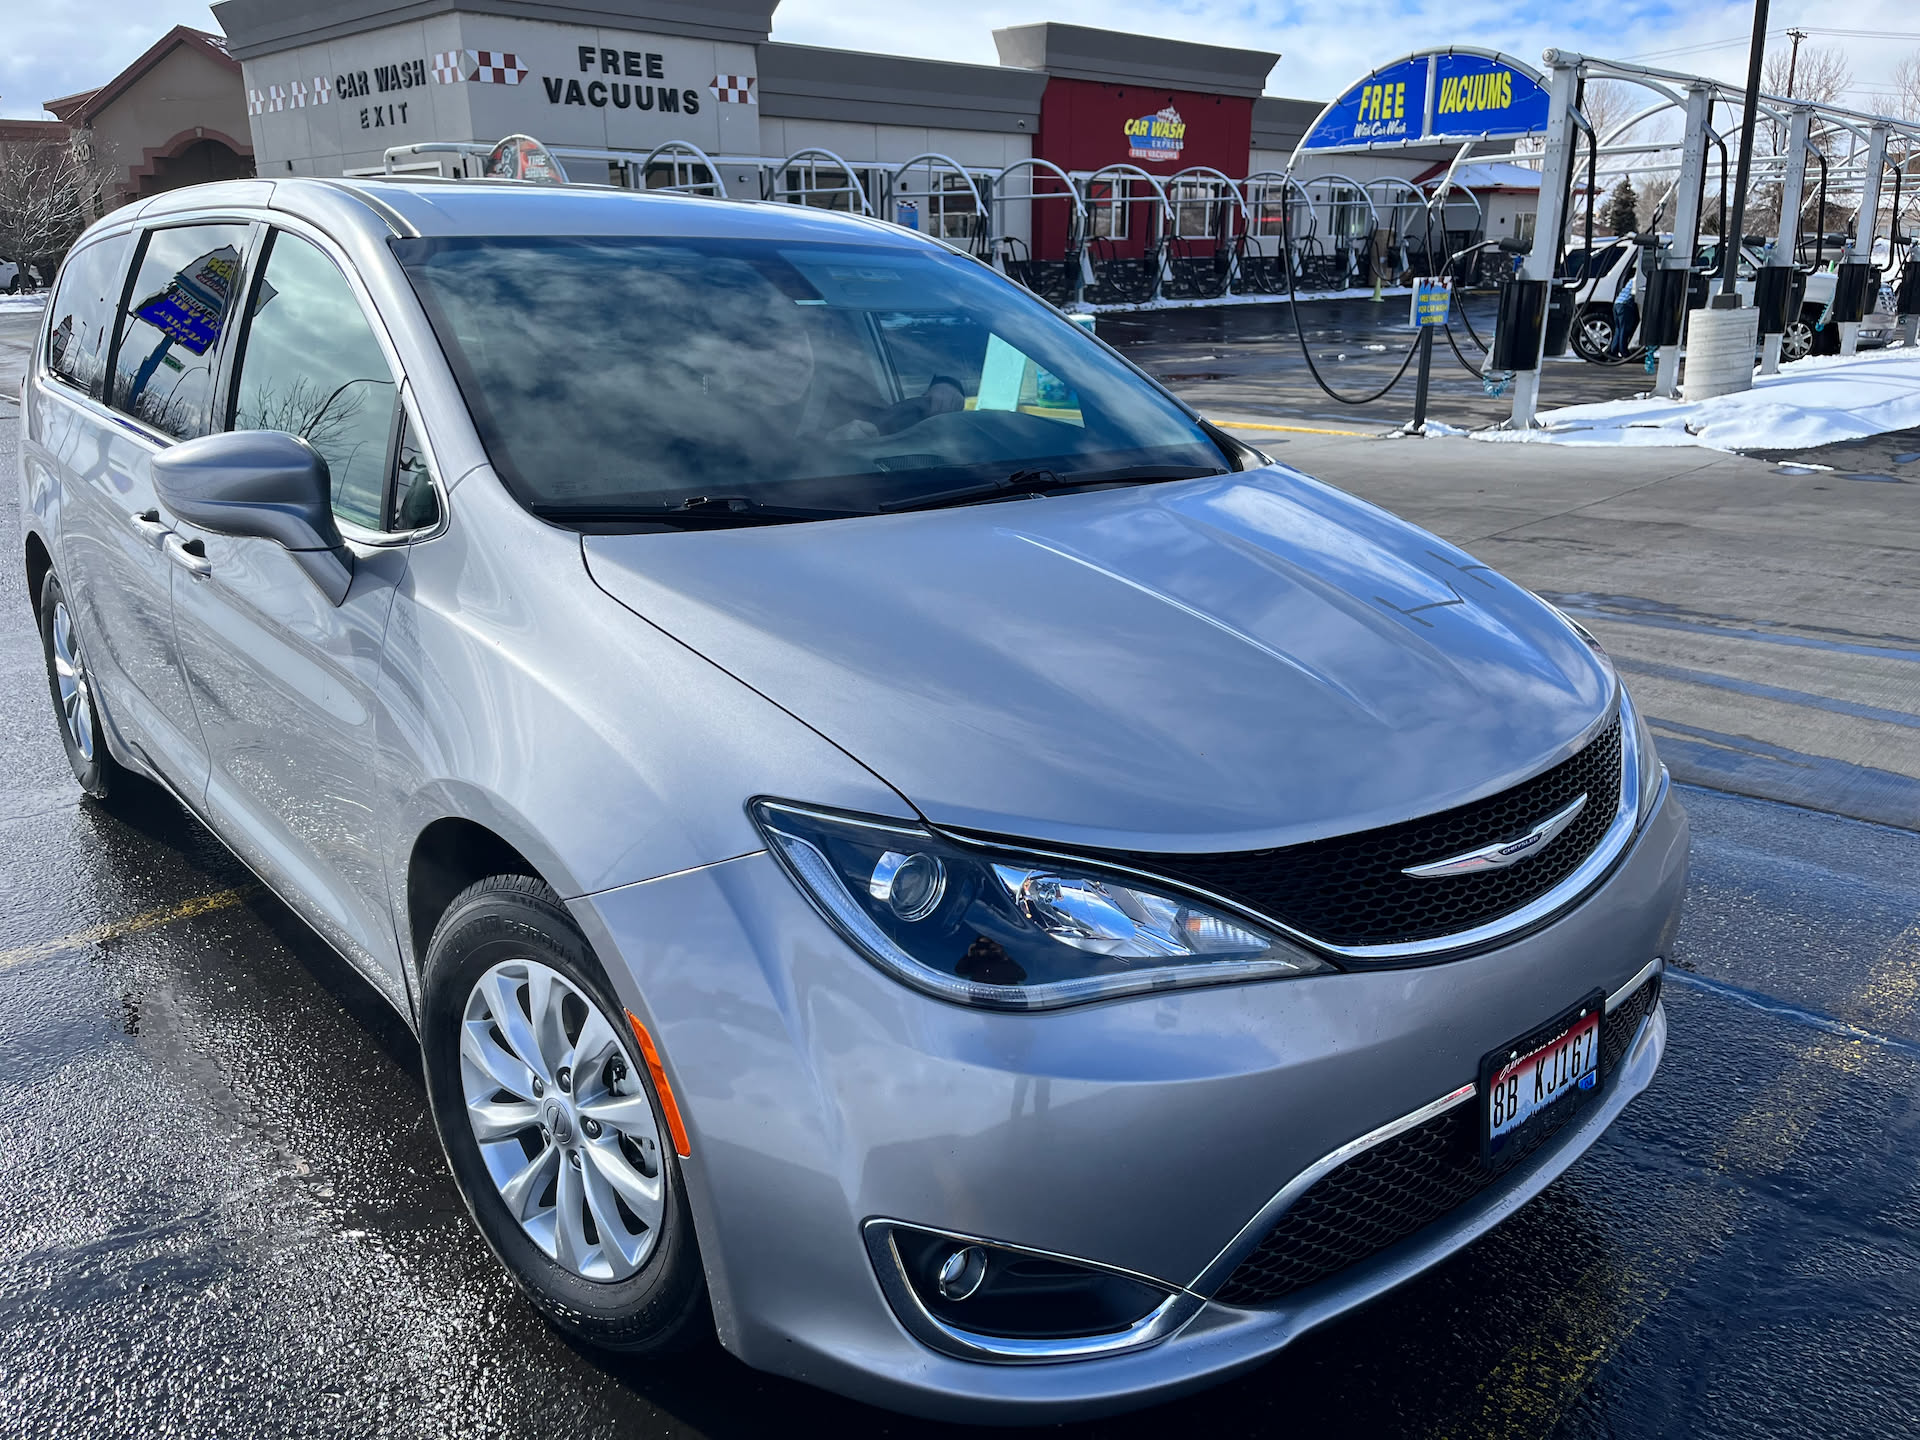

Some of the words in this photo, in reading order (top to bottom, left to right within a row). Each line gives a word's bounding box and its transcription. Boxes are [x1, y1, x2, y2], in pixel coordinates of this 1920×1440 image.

[578, 45, 665, 79] FREE
[335, 69, 369, 101] CAR
[373, 59, 427, 93] WASH
[542, 76, 700, 116] VACUUMS
[1358, 82, 1406, 122] FREE
[1438, 71, 1512, 114] VACUUMS
[359, 101, 408, 129] EXIT
[1124, 118, 1149, 136] CAR
[1151, 121, 1186, 139] WASH
[1354, 122, 1371, 137] With
[1372, 121, 1386, 137] Car
[1387, 119, 1406, 135] Wash
[1132, 149, 1146, 157] FREE
[1148, 150, 1177, 159] VACUUMS
[1152, 140, 1184, 150] EXPRESS
[527, 155, 546, 166] TIRE
[1501, 835, 1540, 855] CHRYSLER
[1493, 1073, 1519, 1129] 8B
[1533, 1026, 1594, 1105] KJ167
